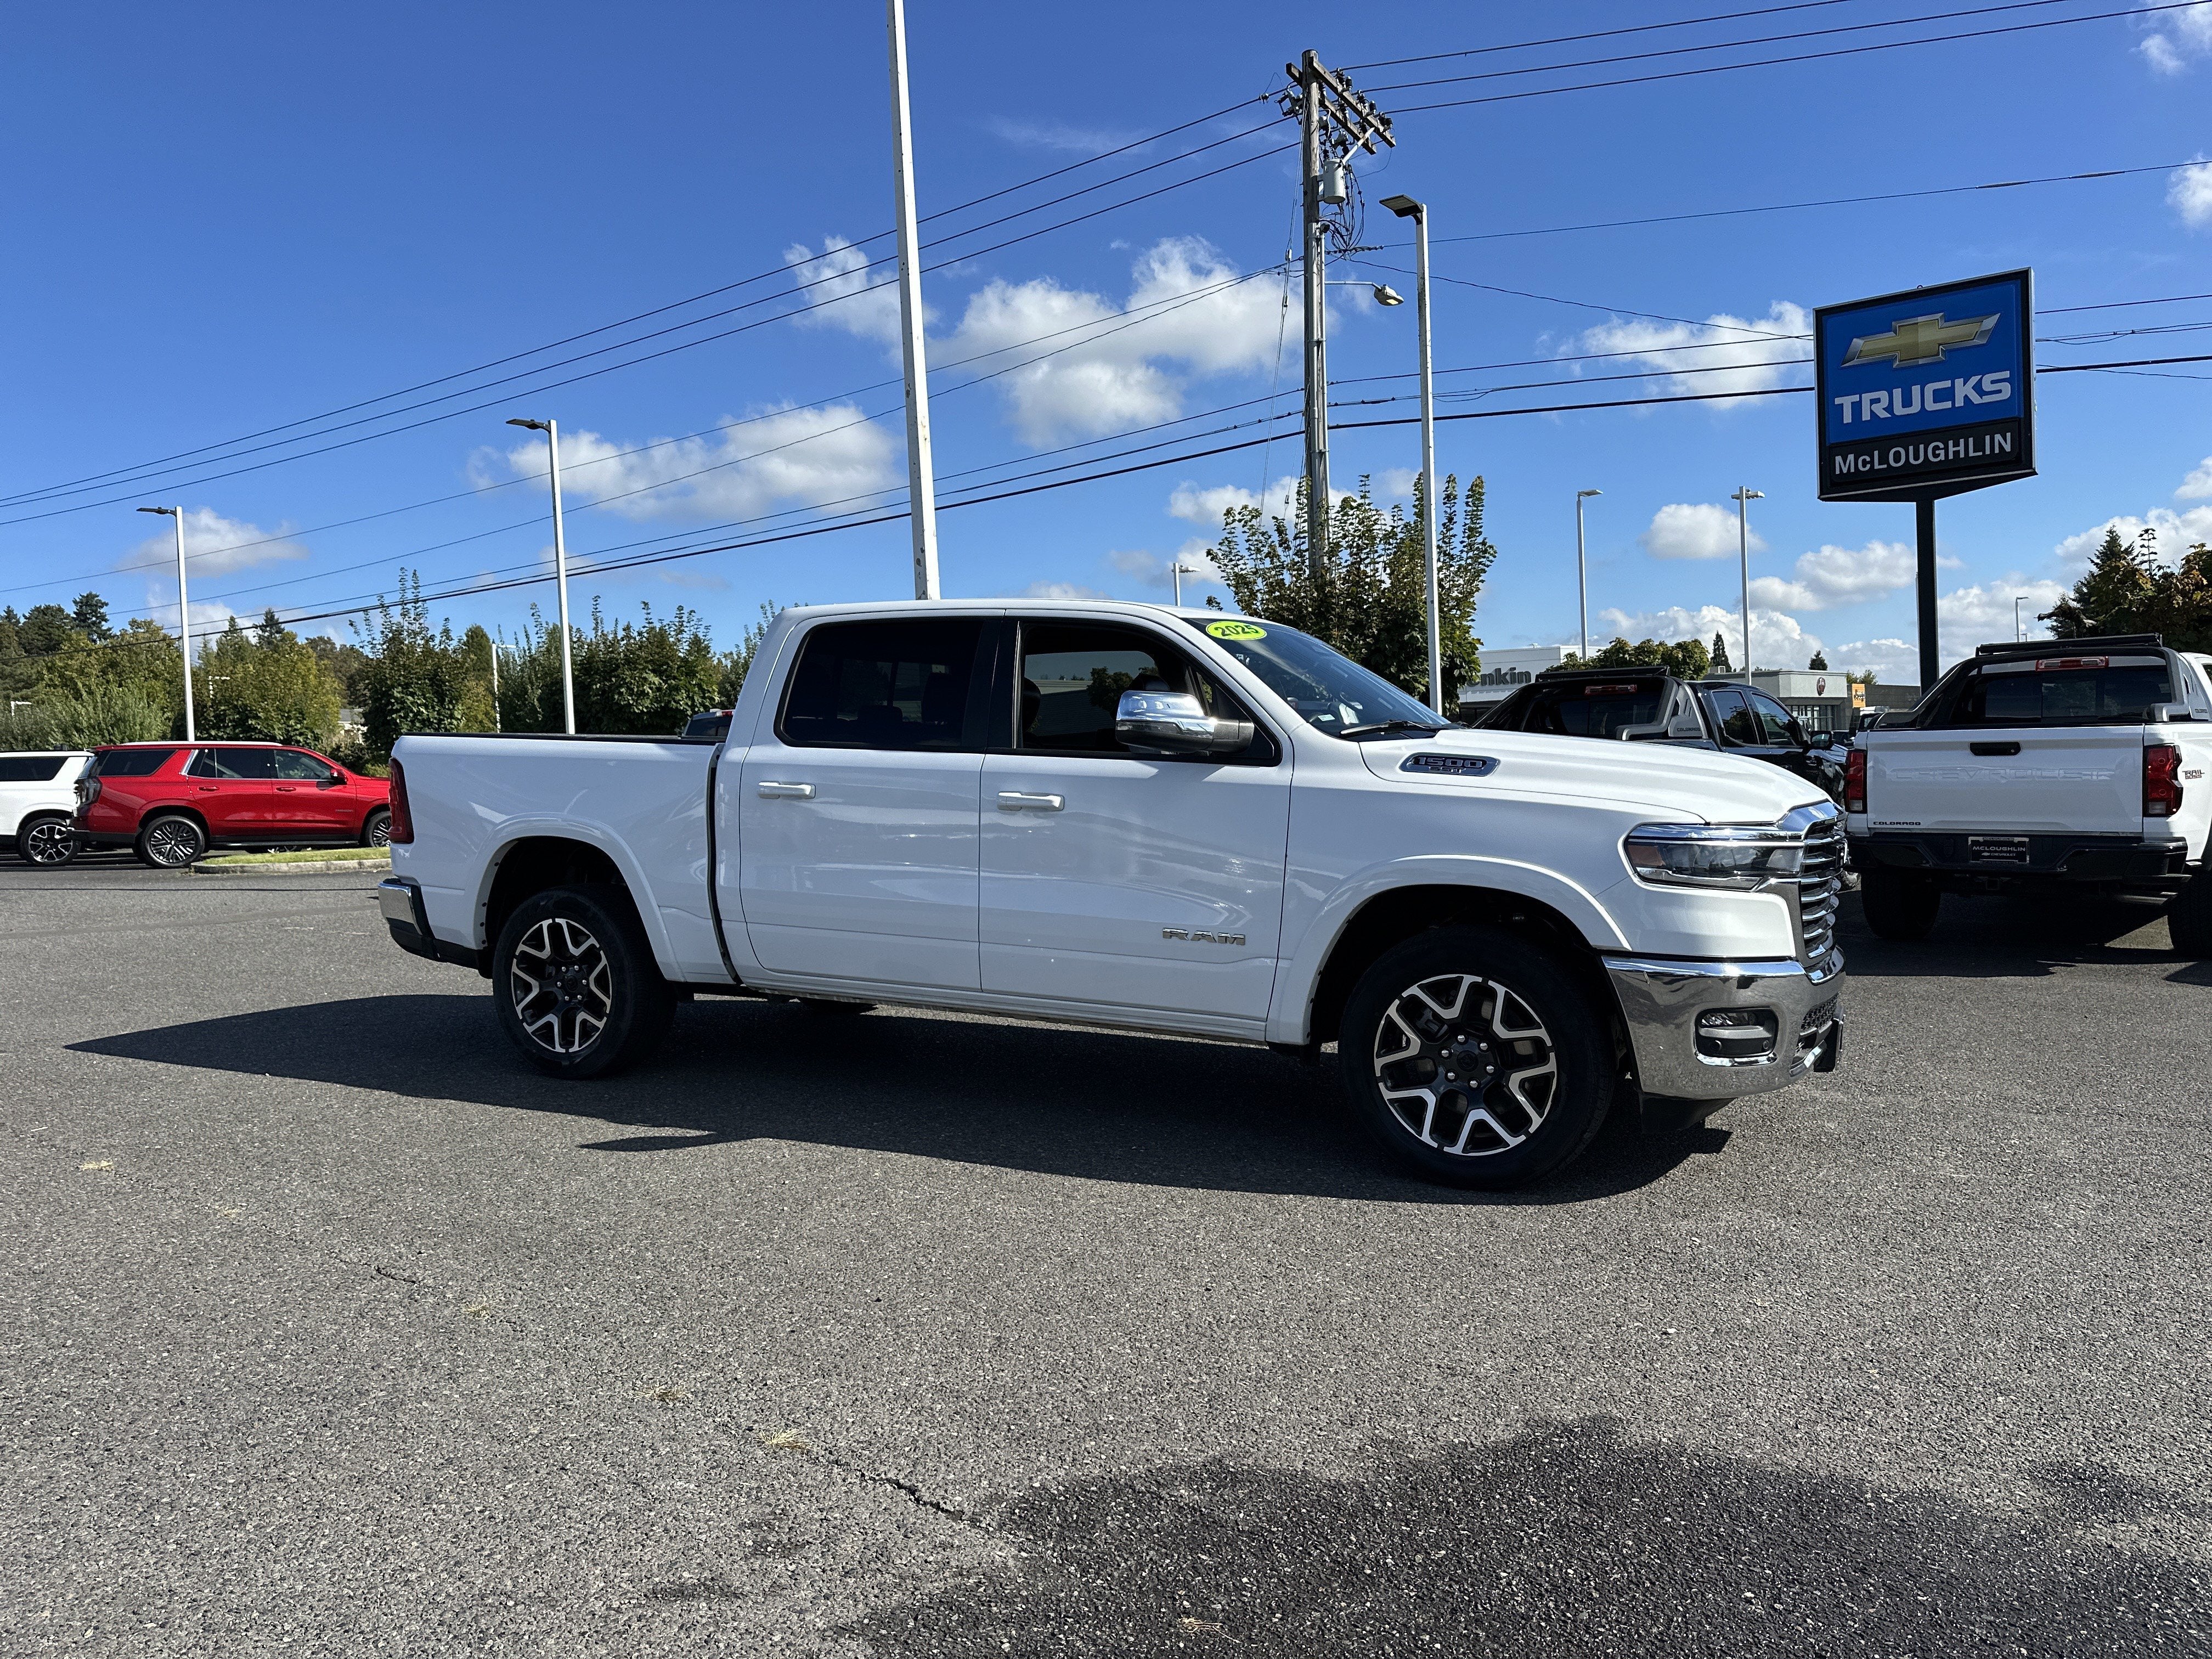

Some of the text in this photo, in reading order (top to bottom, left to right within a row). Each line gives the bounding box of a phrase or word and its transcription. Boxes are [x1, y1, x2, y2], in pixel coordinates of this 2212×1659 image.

[1835, 370, 2011, 424] TRUCKS
[1835, 432, 2012, 475] McLOUGHLIN
[1214, 625, 1260, 637] 2025
[1411, 757, 1482, 768] 1500
[1163, 927, 1246, 945] RAM
